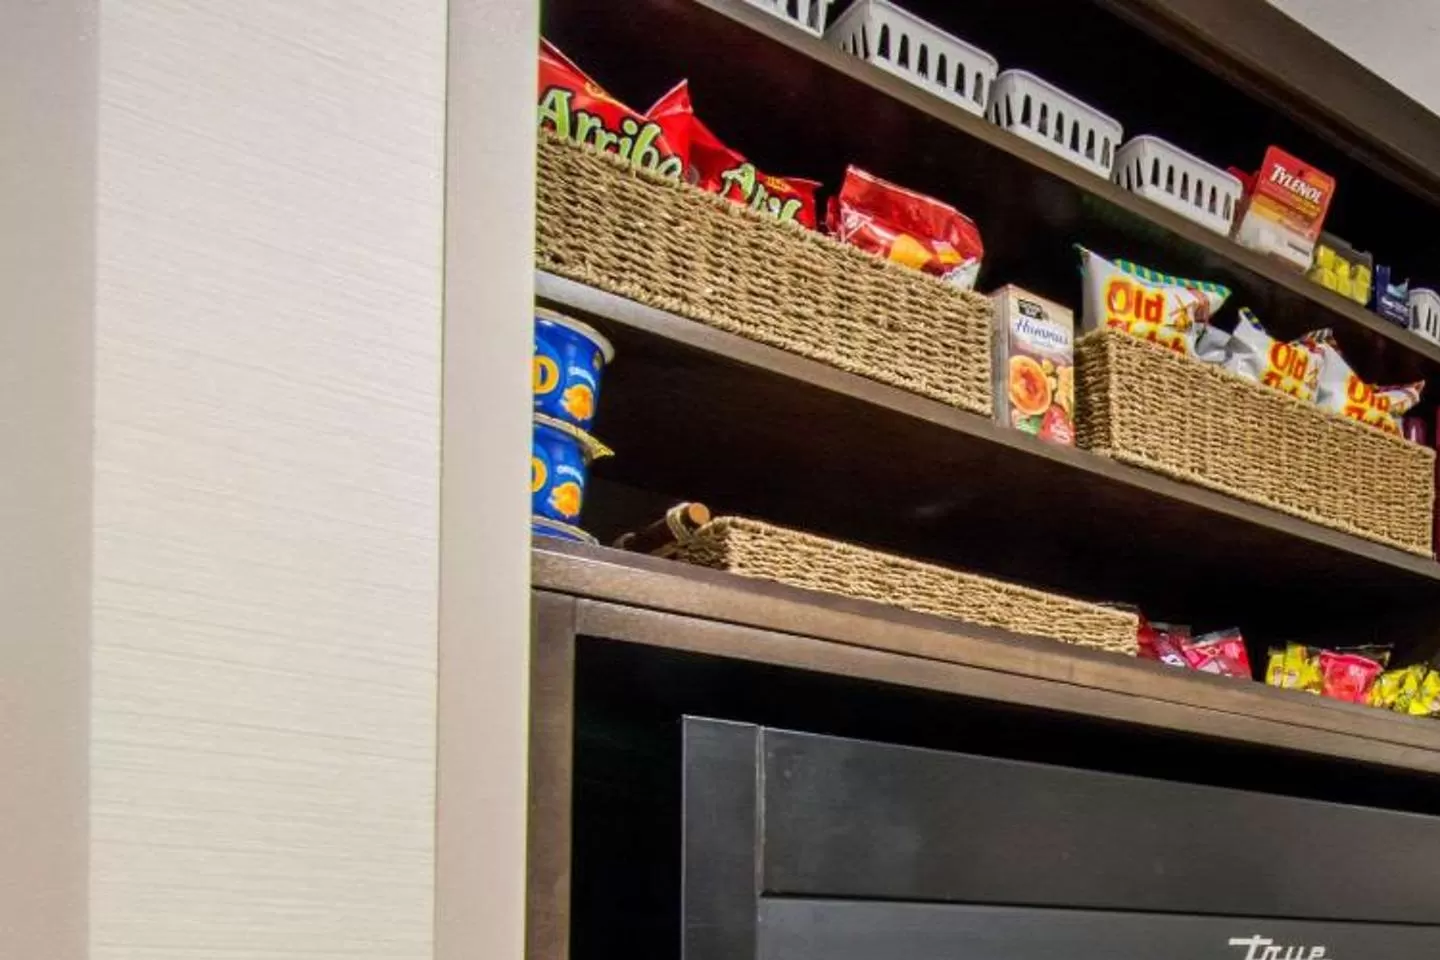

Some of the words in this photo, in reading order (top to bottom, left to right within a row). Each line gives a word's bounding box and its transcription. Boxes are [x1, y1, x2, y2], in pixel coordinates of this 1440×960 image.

[1269, 163, 1322, 204] TYLENOL
[1107, 280, 1165, 323] Old
[1269, 341, 1309, 382] Old
